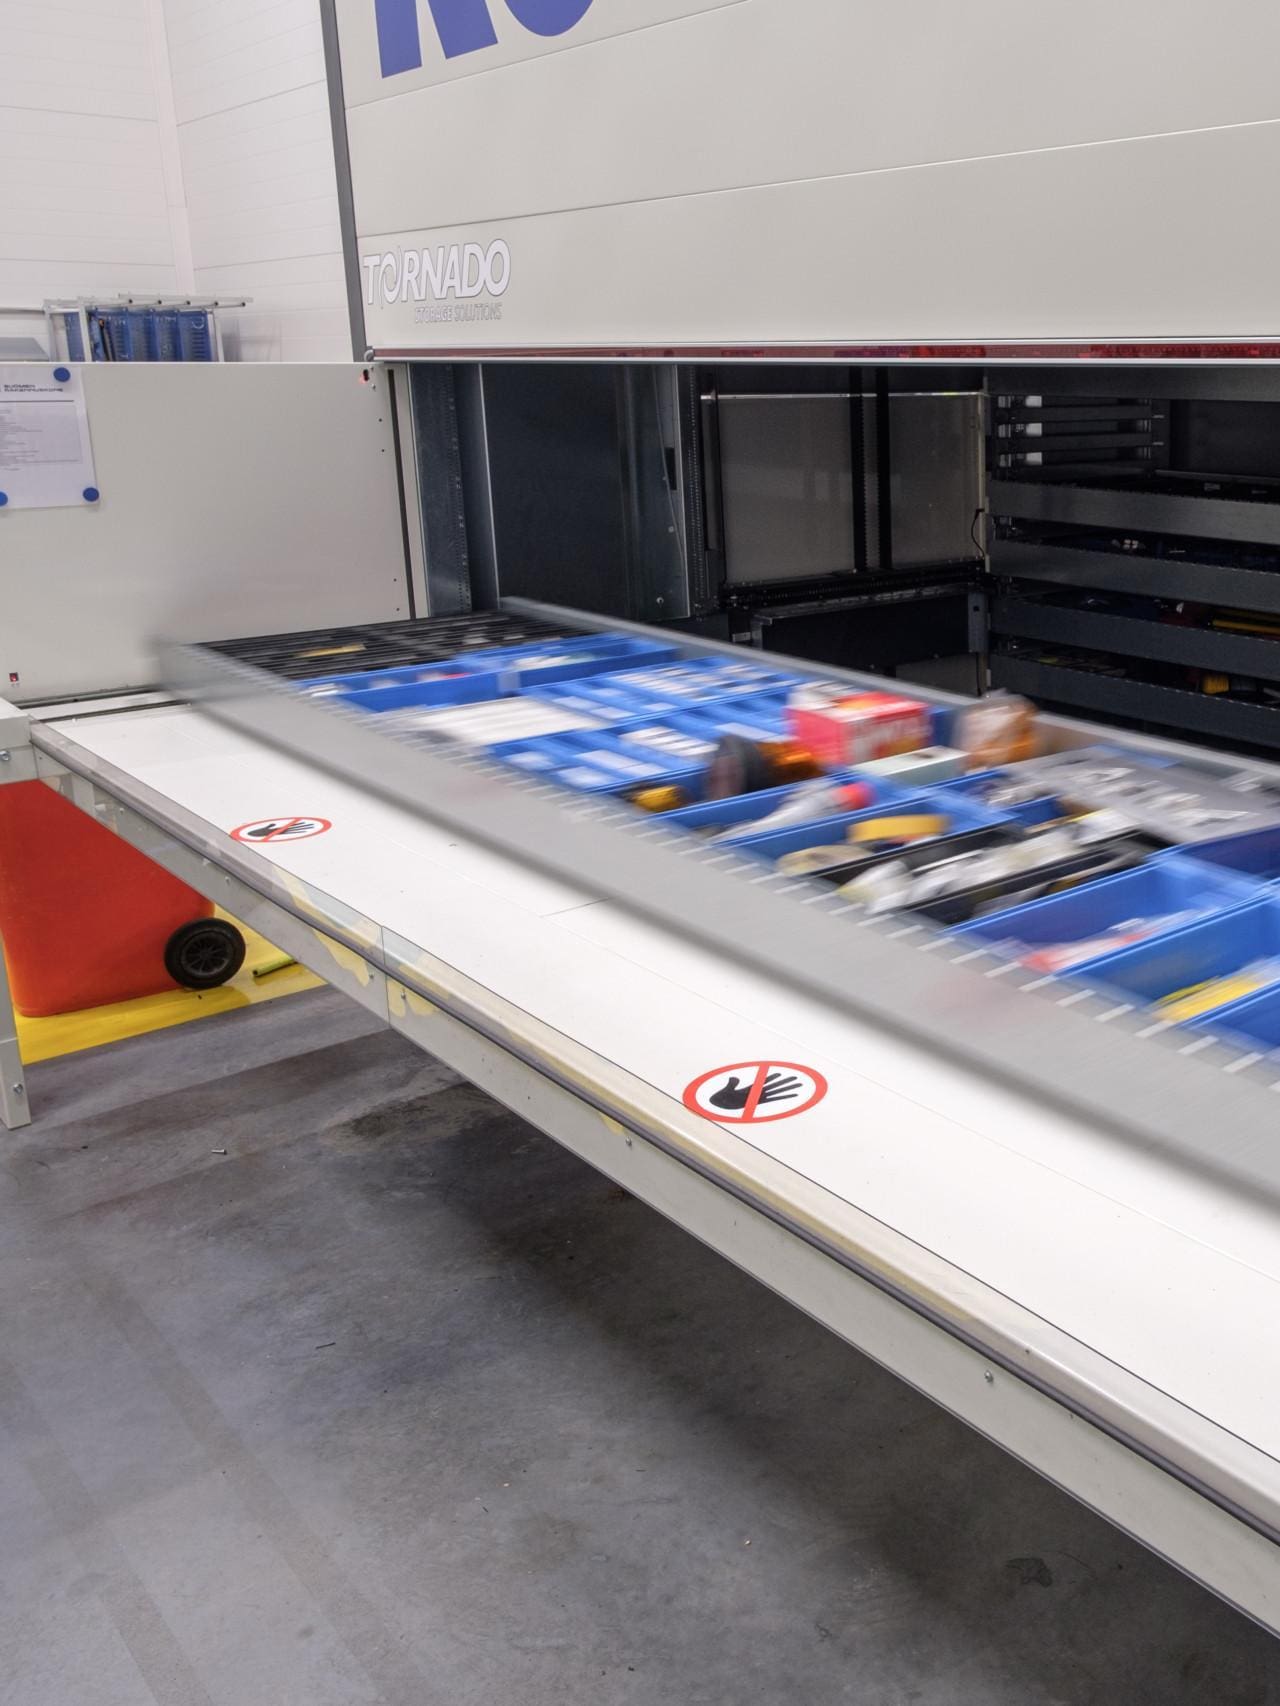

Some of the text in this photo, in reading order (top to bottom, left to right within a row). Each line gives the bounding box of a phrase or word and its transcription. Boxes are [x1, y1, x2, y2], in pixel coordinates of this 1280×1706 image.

[362, 238, 511, 304] TORNADO
[415, 303, 502, 323] STORAGE SOLUTIONS
